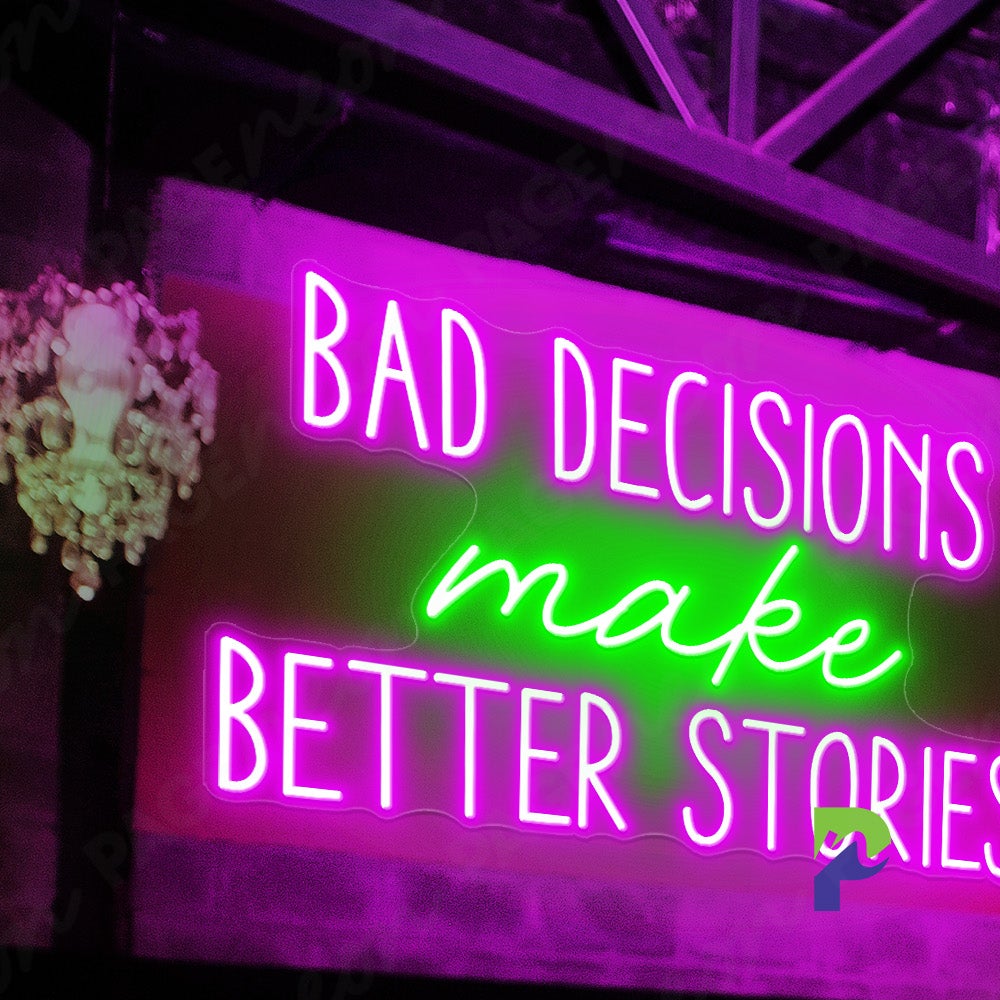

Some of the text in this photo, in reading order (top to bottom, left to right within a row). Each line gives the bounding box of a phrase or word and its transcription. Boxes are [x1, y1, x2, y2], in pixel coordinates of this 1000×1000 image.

[301, 268, 986, 572] BAD DECISIONS
[424, 541, 905, 691] make
[215, 632, 629, 834] BETTER
